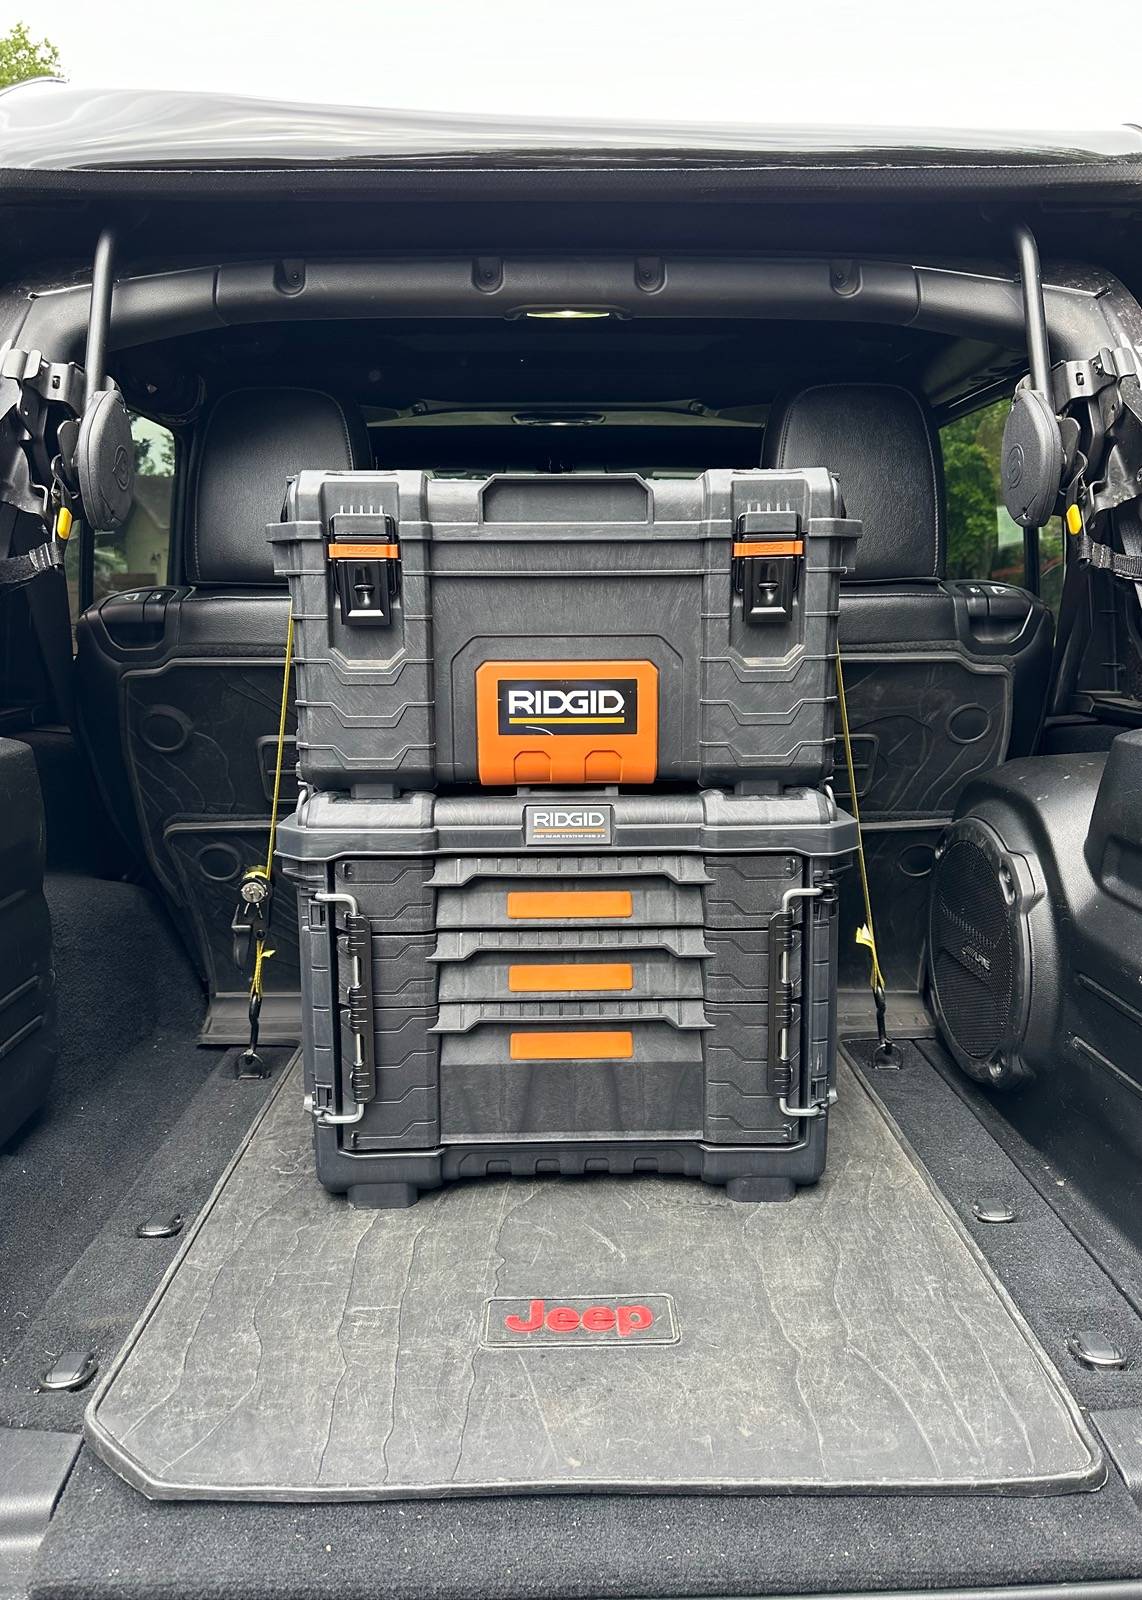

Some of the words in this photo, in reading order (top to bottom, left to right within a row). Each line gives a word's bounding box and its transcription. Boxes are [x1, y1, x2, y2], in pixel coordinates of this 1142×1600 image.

[508, 690, 625, 714] RIDGID
[533, 812, 605, 827] RIDGID
[504, 1299, 653, 1337] Jeep
